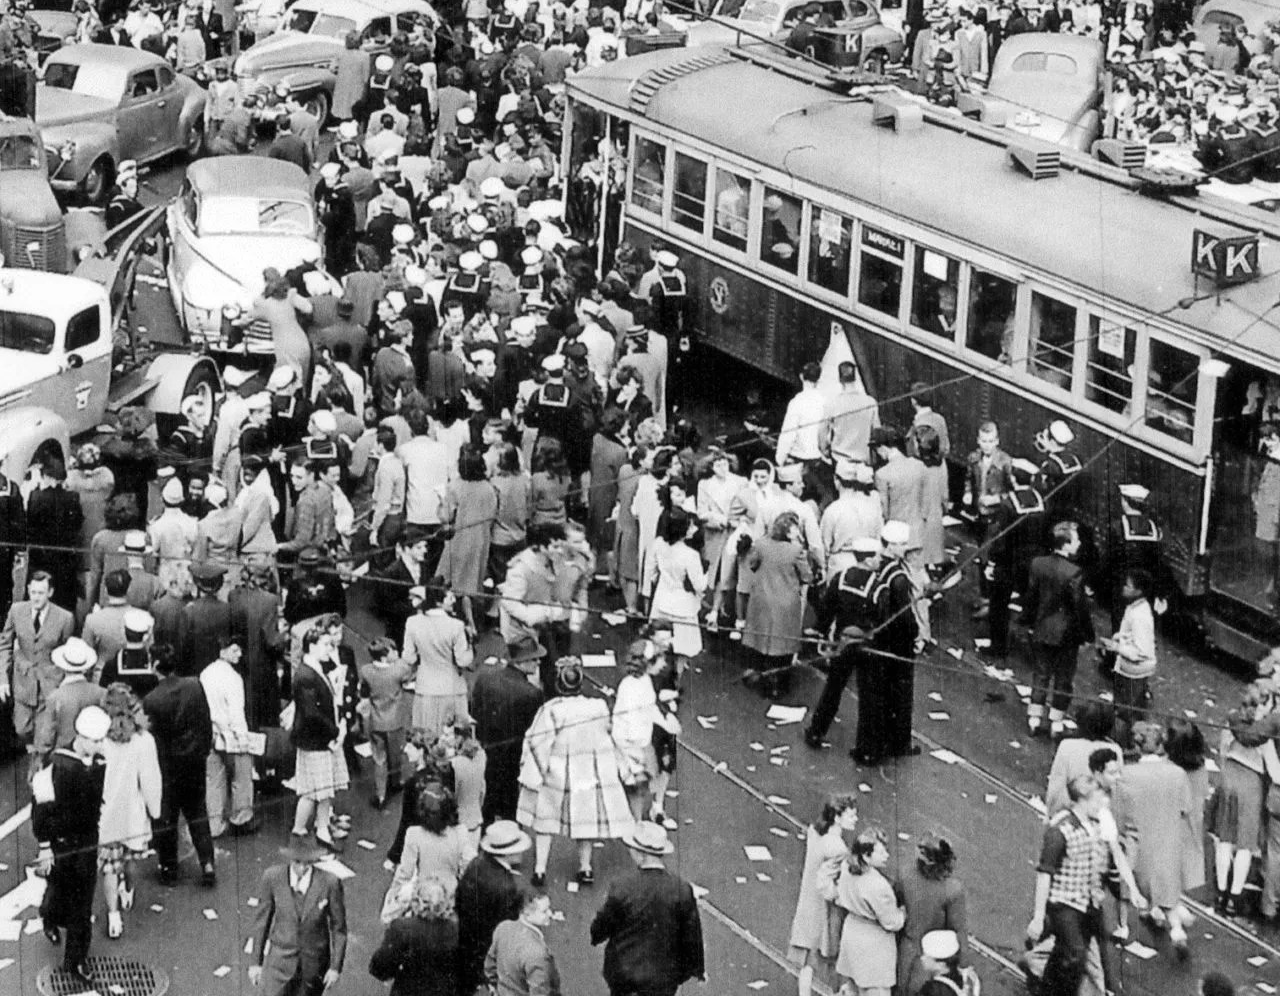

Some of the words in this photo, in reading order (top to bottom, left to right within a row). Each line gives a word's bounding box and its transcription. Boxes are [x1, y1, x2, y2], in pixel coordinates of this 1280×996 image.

[845, 34, 859, 53] K
[1197, 233, 1219, 271] K
[1226, 243, 1254, 277] K
